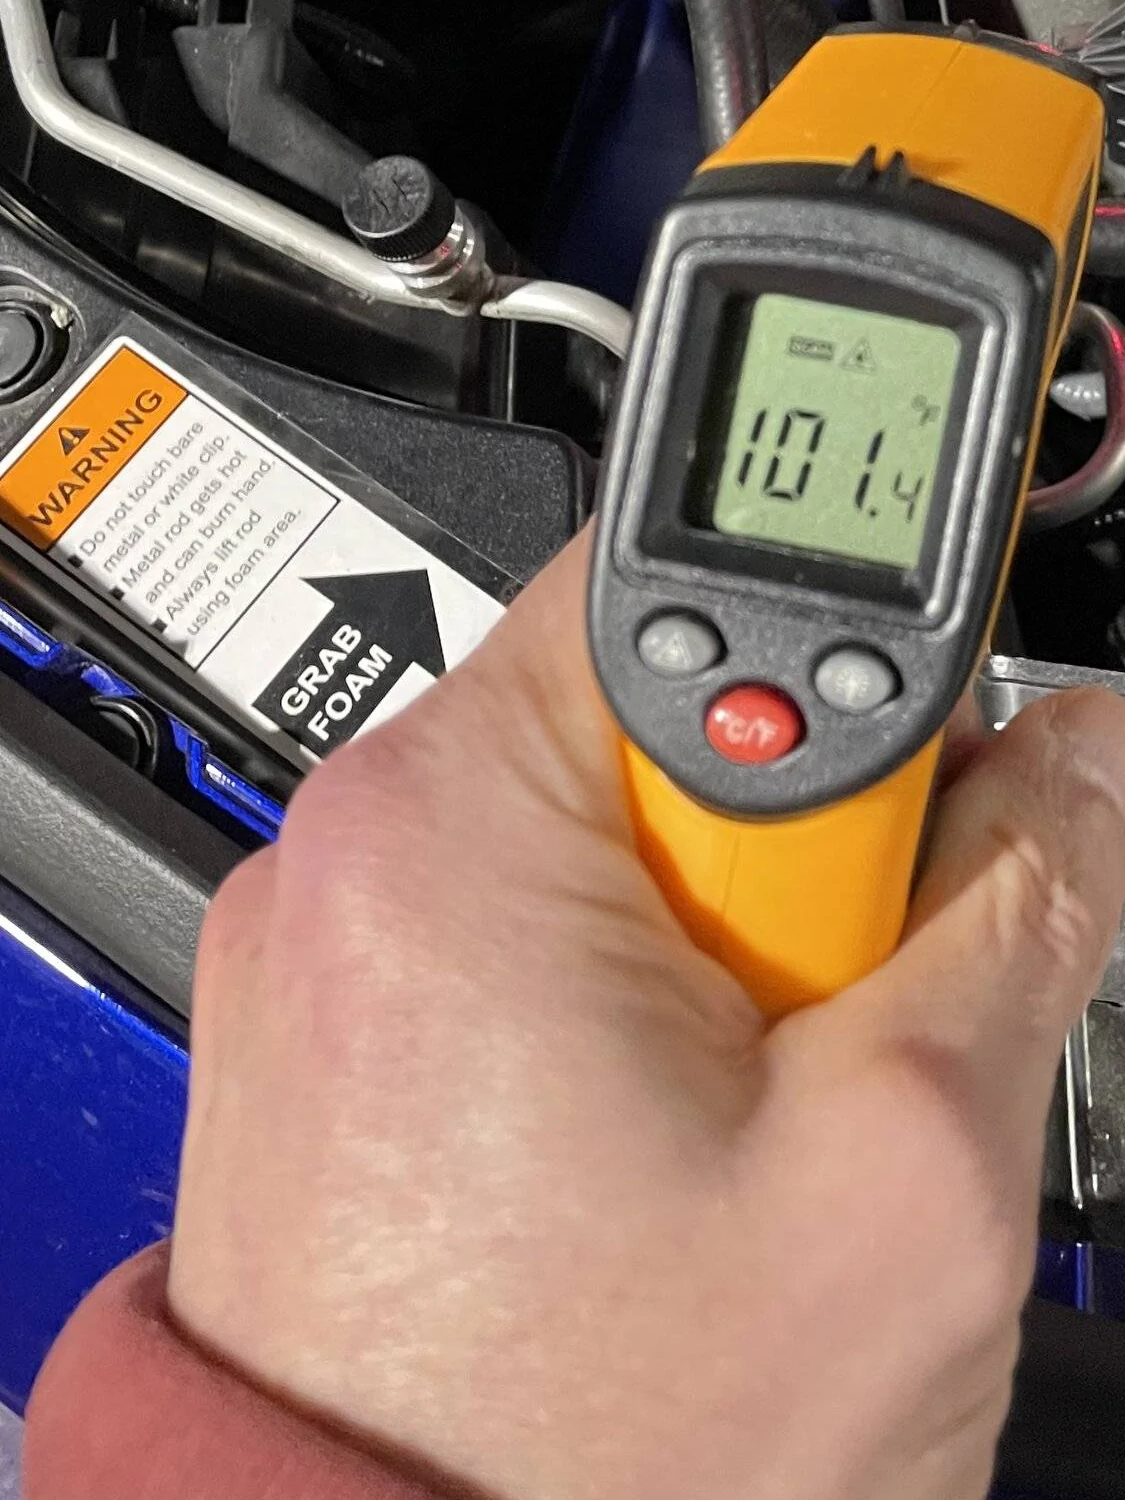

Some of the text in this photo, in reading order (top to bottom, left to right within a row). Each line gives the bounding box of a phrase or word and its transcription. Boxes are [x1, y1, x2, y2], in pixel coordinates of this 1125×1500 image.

[27, 388, 164, 530] WARNING
[79, 421, 204, 557] Do not touch bare
[103, 435, 232, 574] metal or white clip.
[121, 450, 248, 588] Metal rod gets hot
[737, 407, 924, 524] 101.4
[145, 458, 276, 605] and can burn hand.
[165, 508, 262, 622] Always lift rod
[186, 508, 302, 636] using foam area.
[280, 623, 362, 717] GRAB
[307, 643, 393, 742] FOAM
